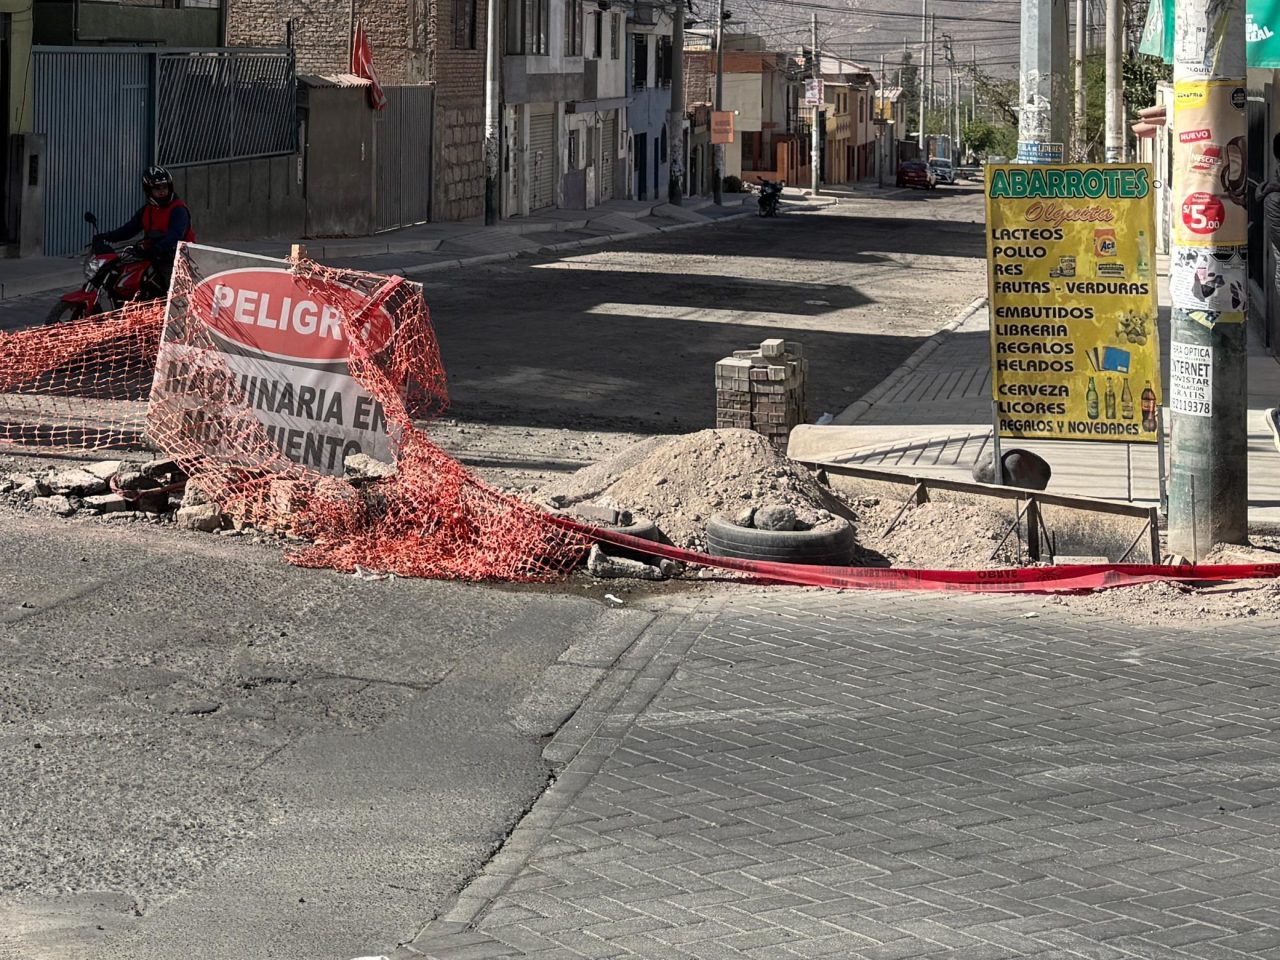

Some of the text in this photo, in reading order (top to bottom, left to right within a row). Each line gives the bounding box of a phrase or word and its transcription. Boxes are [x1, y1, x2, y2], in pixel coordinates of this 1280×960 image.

[1180, 131, 1208, 140] NUEVO
[990, 168, 1149, 199] ABARROTES
[1024, 201, 1114, 228] Olguita
[992, 228, 1064, 240] LACTEOS
[993, 246, 1047, 258] POLLO
[994, 263, 1023, 275] RES
[995, 281, 1050, 294] FRUTAS
[1066, 282, 1149, 295] VERDURAS
[211, 284, 372, 344] PELIGR
[996, 306, 1094, 319] EMBUTIDOS
[996, 324, 1068, 336] LIBRERIA
[997, 342, 1074, 354] REGALOS
[1184, 346, 1210, 358] OPTICA
[997, 359, 1074, 372] HELADOS
[998, 384, 1069, 397] CERVEZA
[999, 402, 1066, 414] LICORES
[999, 419, 1139, 435] REGALOS Y NOVEDADES
